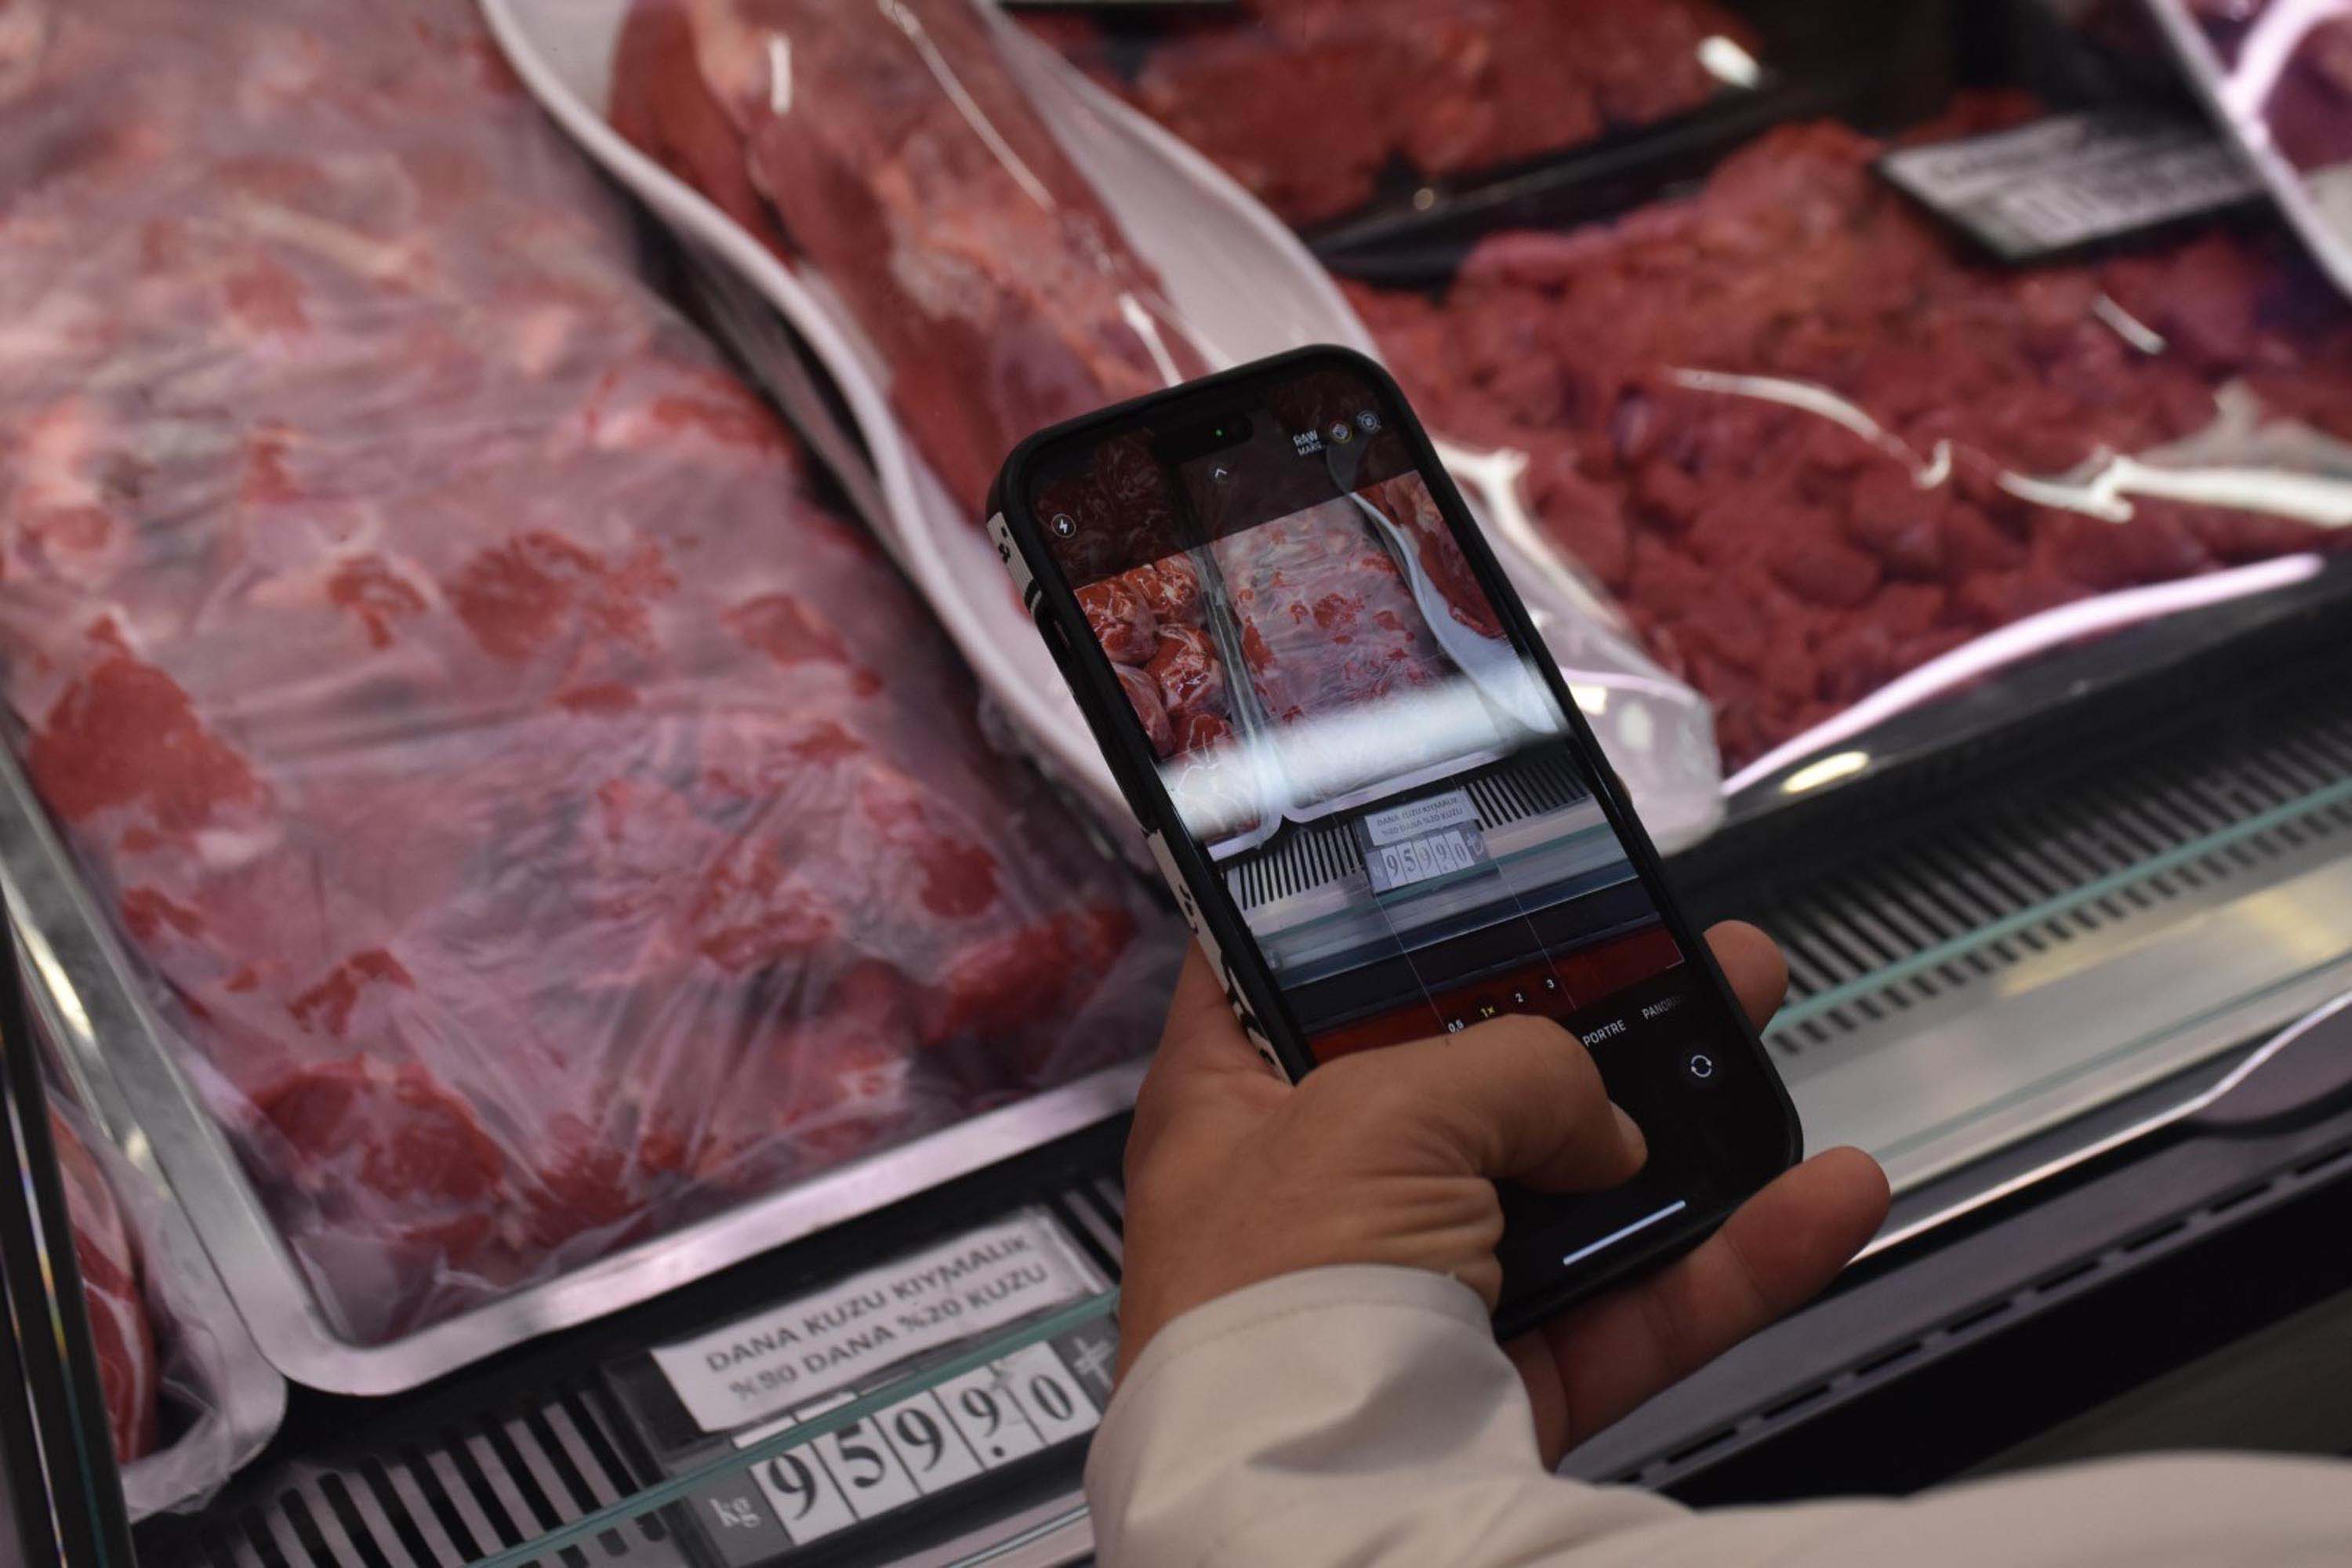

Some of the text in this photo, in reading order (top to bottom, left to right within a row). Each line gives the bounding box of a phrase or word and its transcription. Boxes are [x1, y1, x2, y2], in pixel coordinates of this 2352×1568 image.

[1515, 993, 1523, 1003] 2
[1546, 979, 1554, 988] 3
[1582, 1019, 1627, 1047] PORTRE
[706, 1236, 1029, 1372] DANA KUZU KIYMALIK
[803, 1327, 893, 1373] DANA
[895, 1299, 962, 1334] %20
[967, 1262, 1049, 1311] KUZU
[710, 1495, 760, 1528] kg
